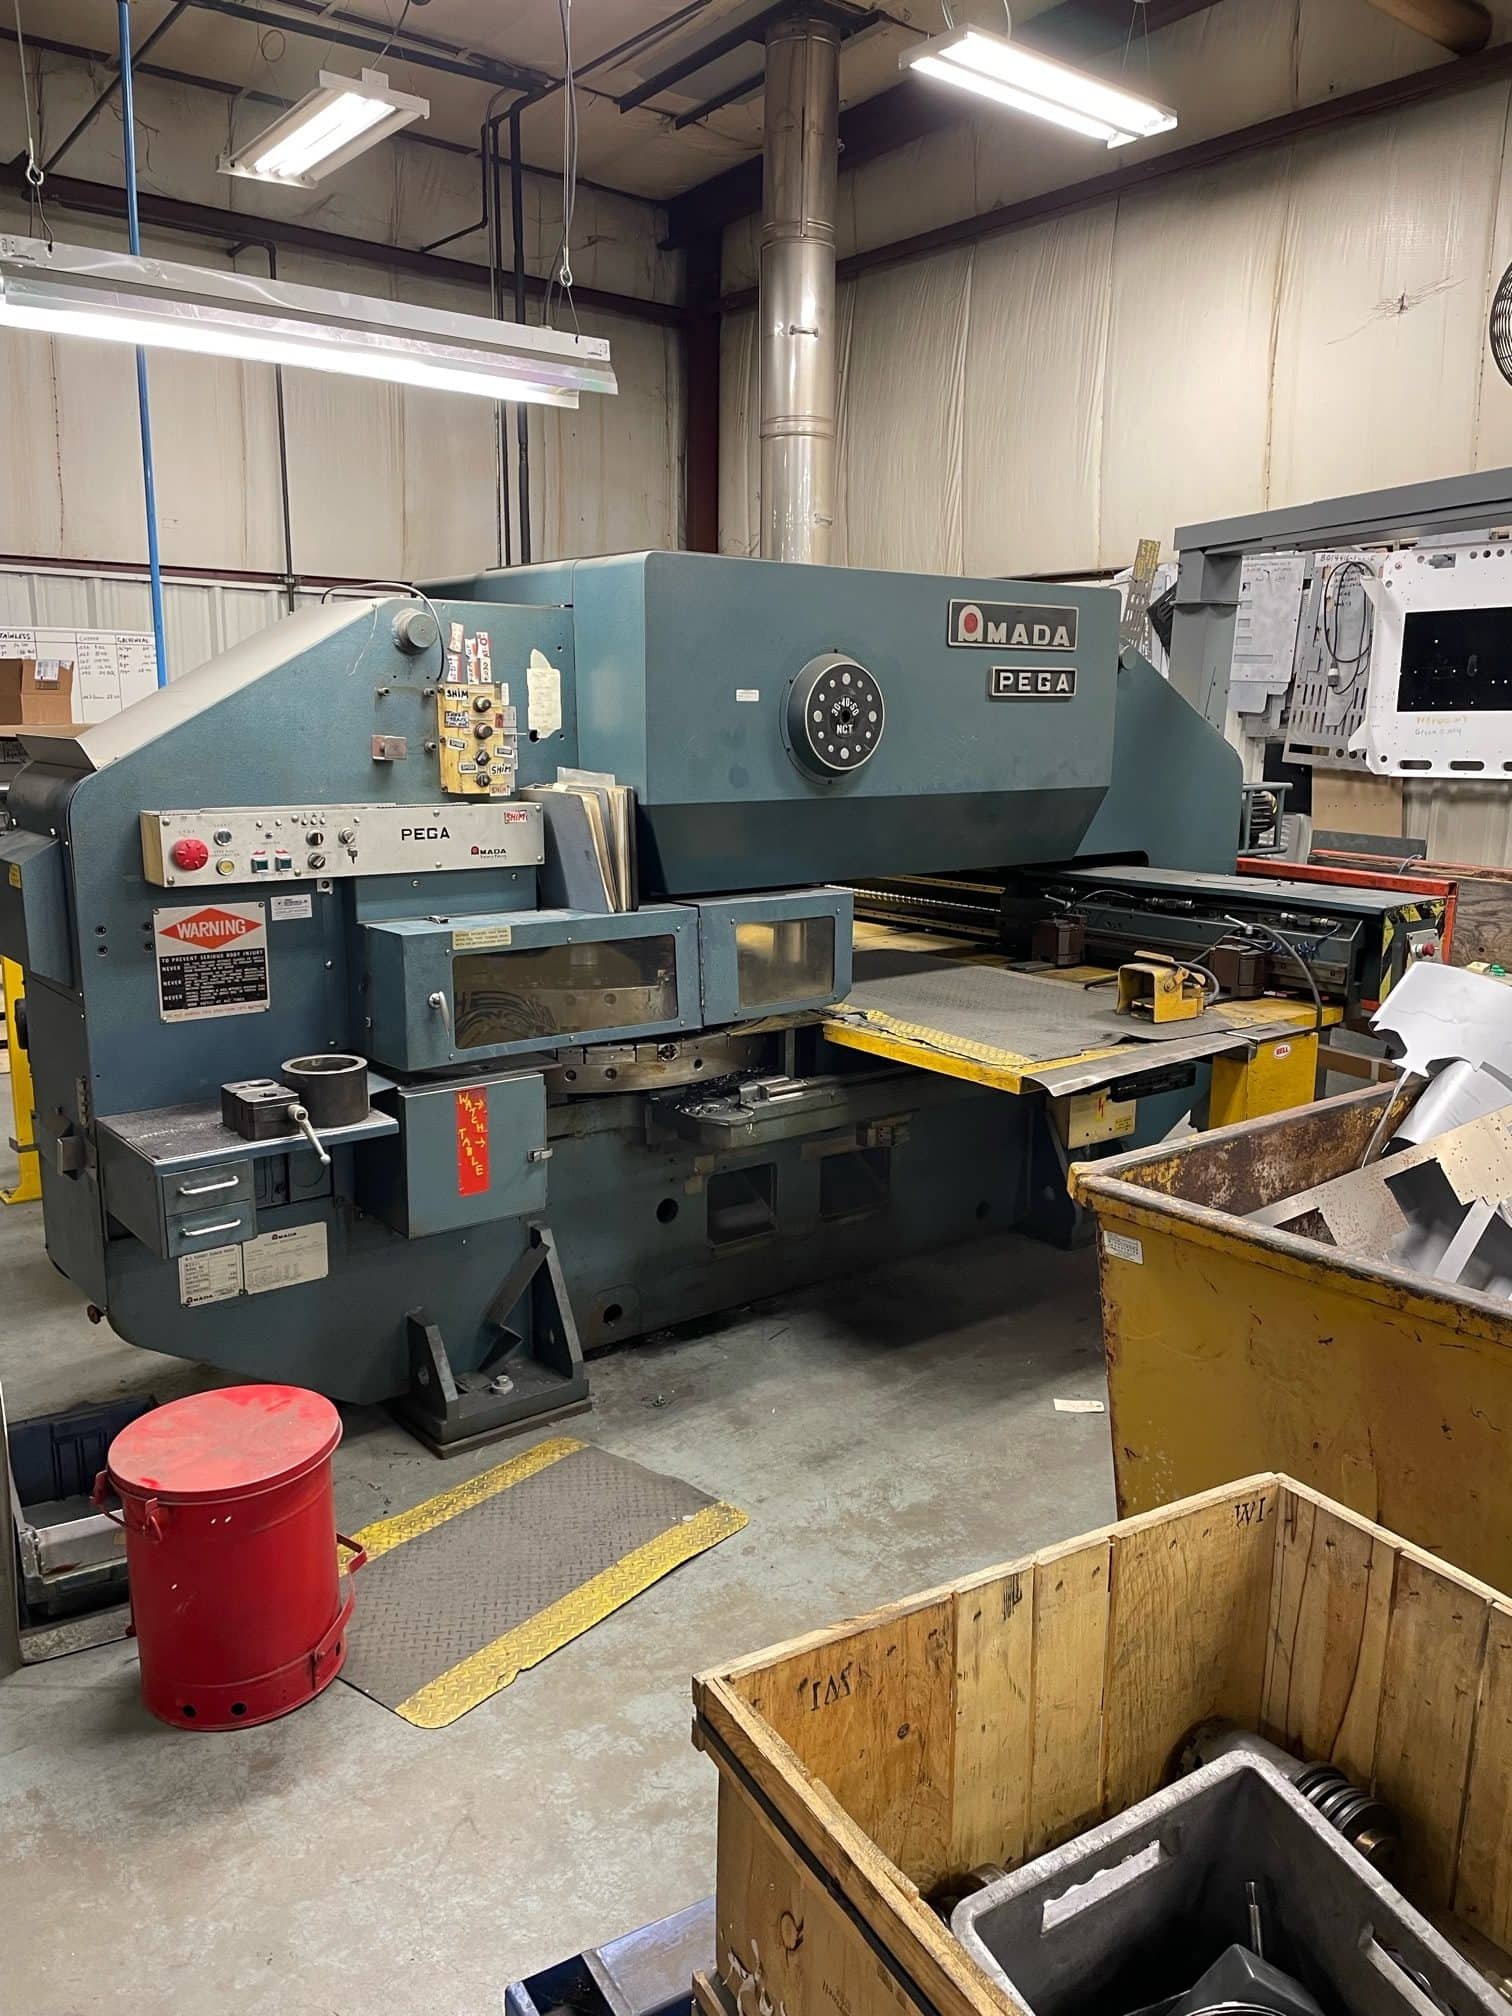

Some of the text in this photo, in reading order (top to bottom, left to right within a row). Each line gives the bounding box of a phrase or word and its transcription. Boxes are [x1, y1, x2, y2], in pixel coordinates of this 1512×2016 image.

[957, 604, 1071, 647] AMADA
[999, 672, 1070, 692] PEGA
[836, 724, 854, 735] NCT
[401, 827, 450, 841] PEGA
[176, 919, 247, 939] WARNING
